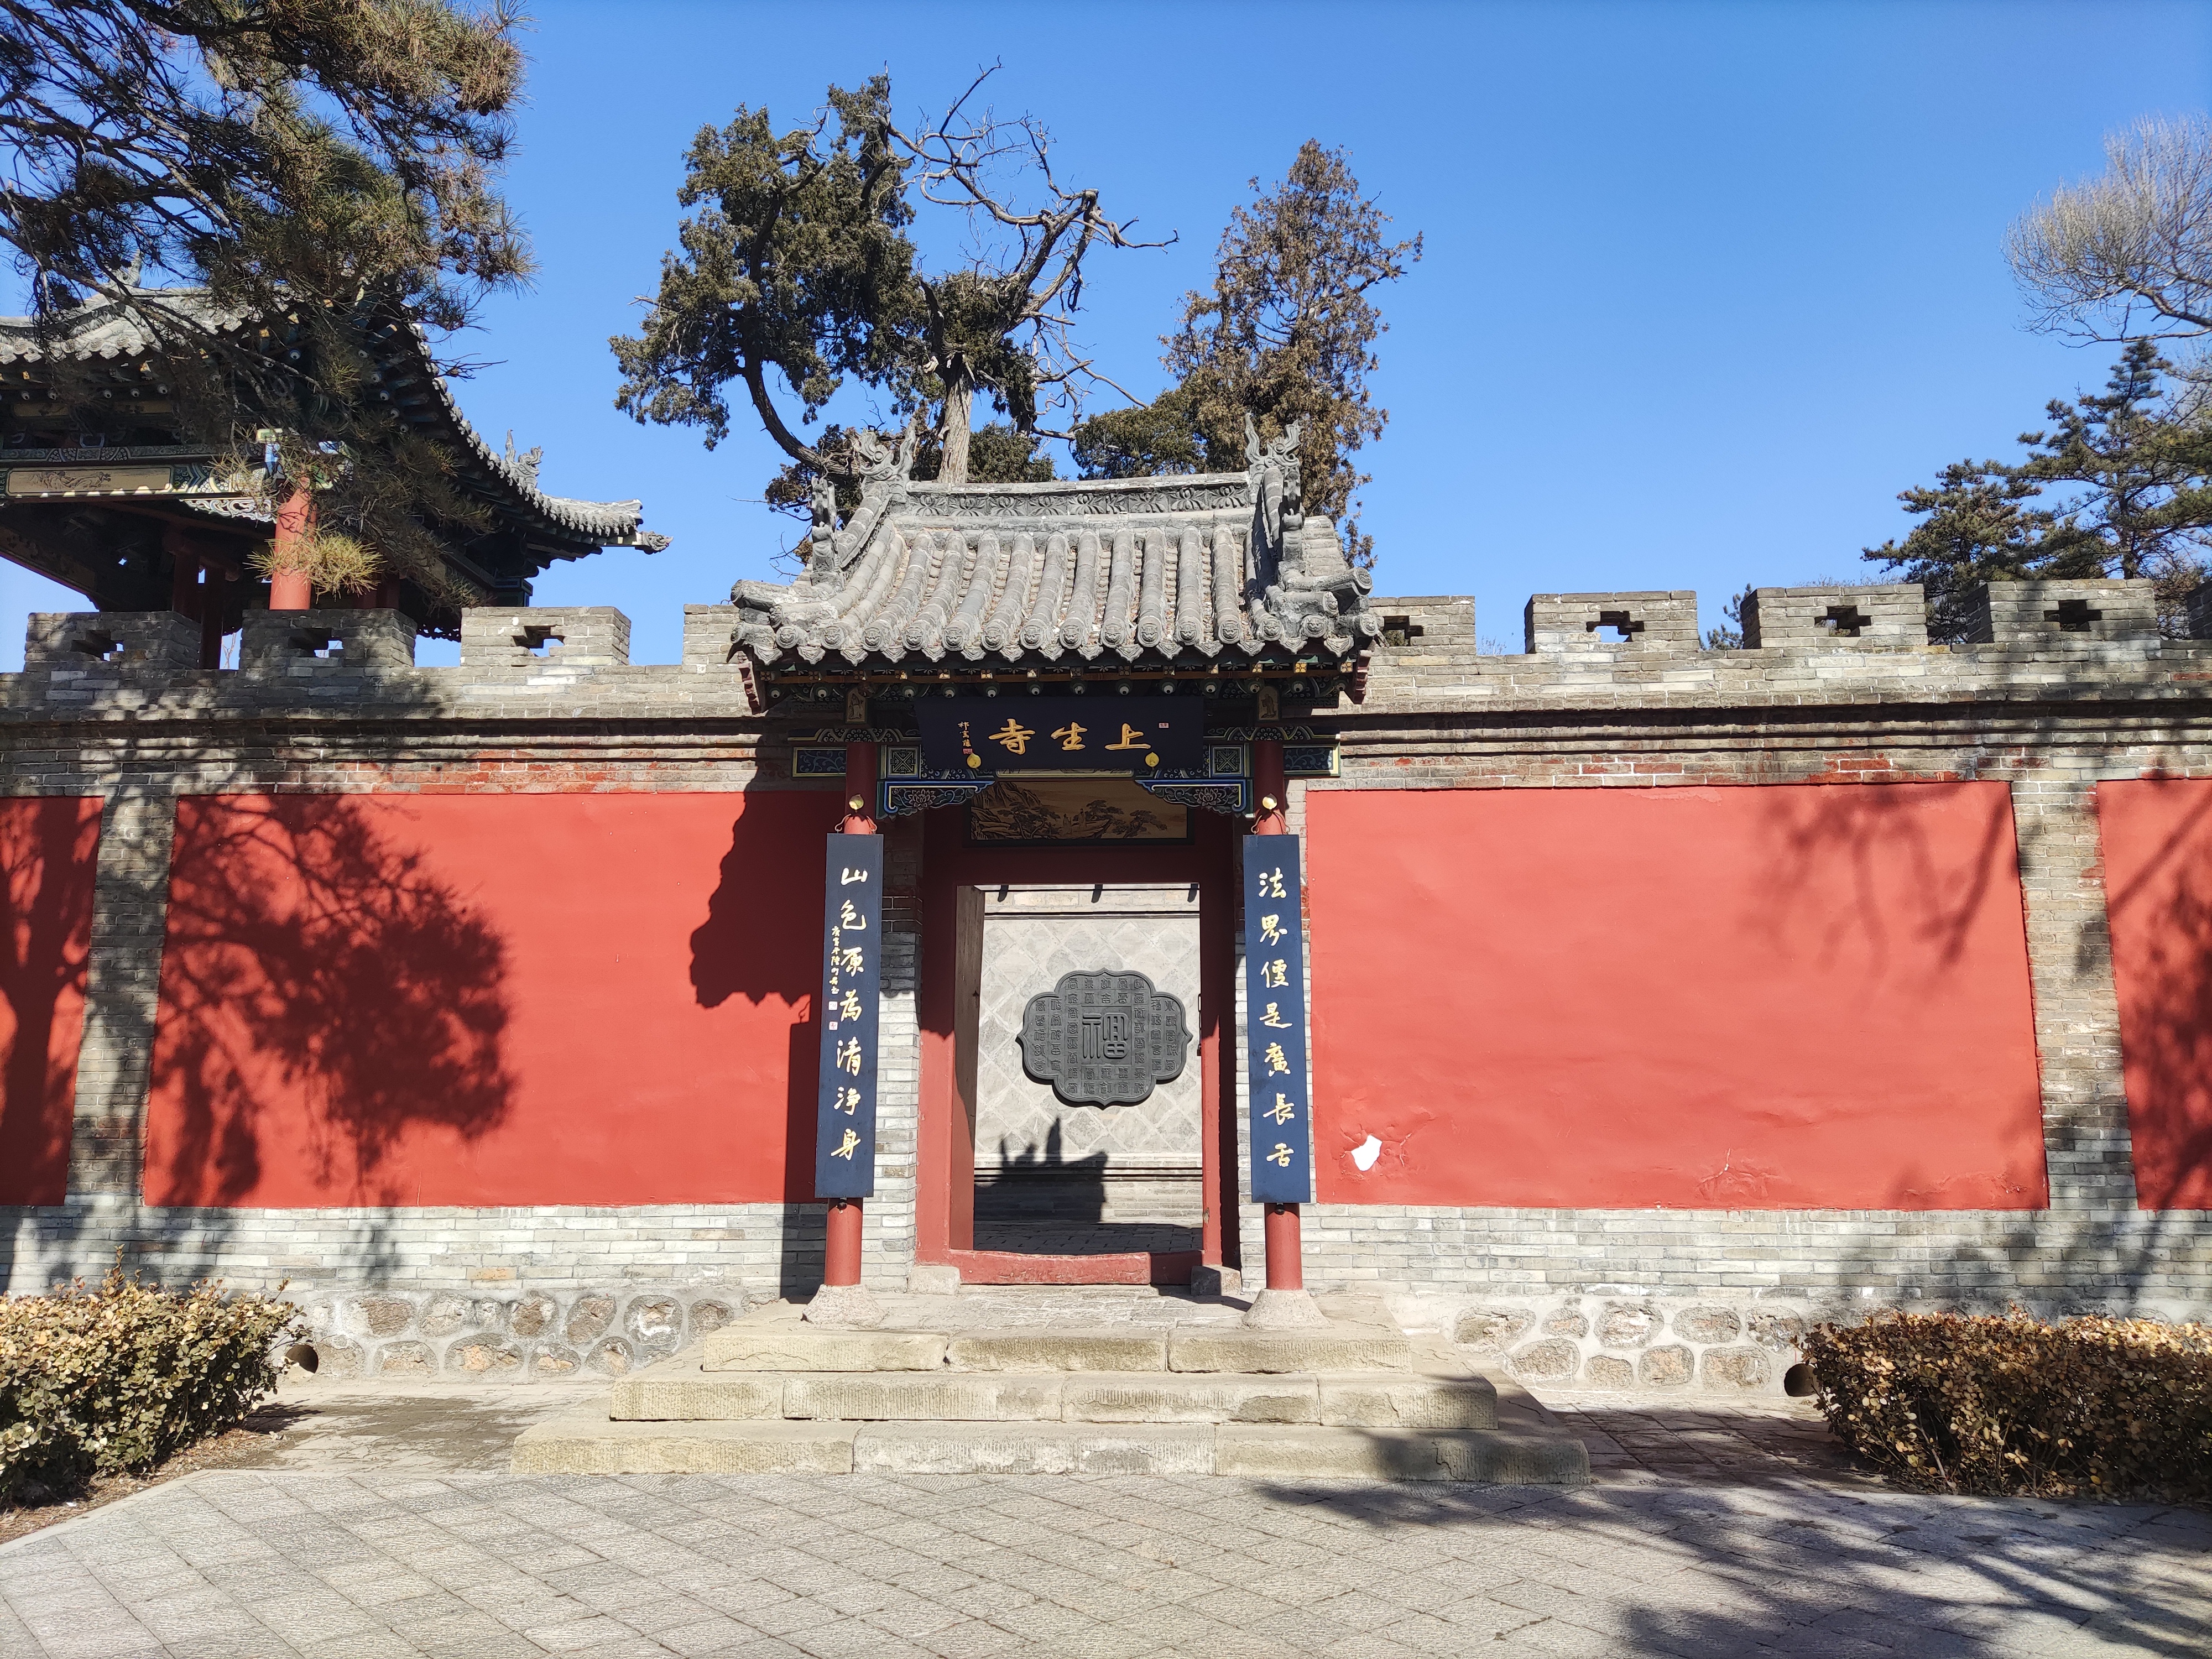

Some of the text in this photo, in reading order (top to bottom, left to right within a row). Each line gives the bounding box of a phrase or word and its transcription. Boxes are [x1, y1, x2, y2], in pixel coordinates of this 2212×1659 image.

[988, 718, 1151, 755] 上生寺
[1082, 1012, 1129, 1060] 福
